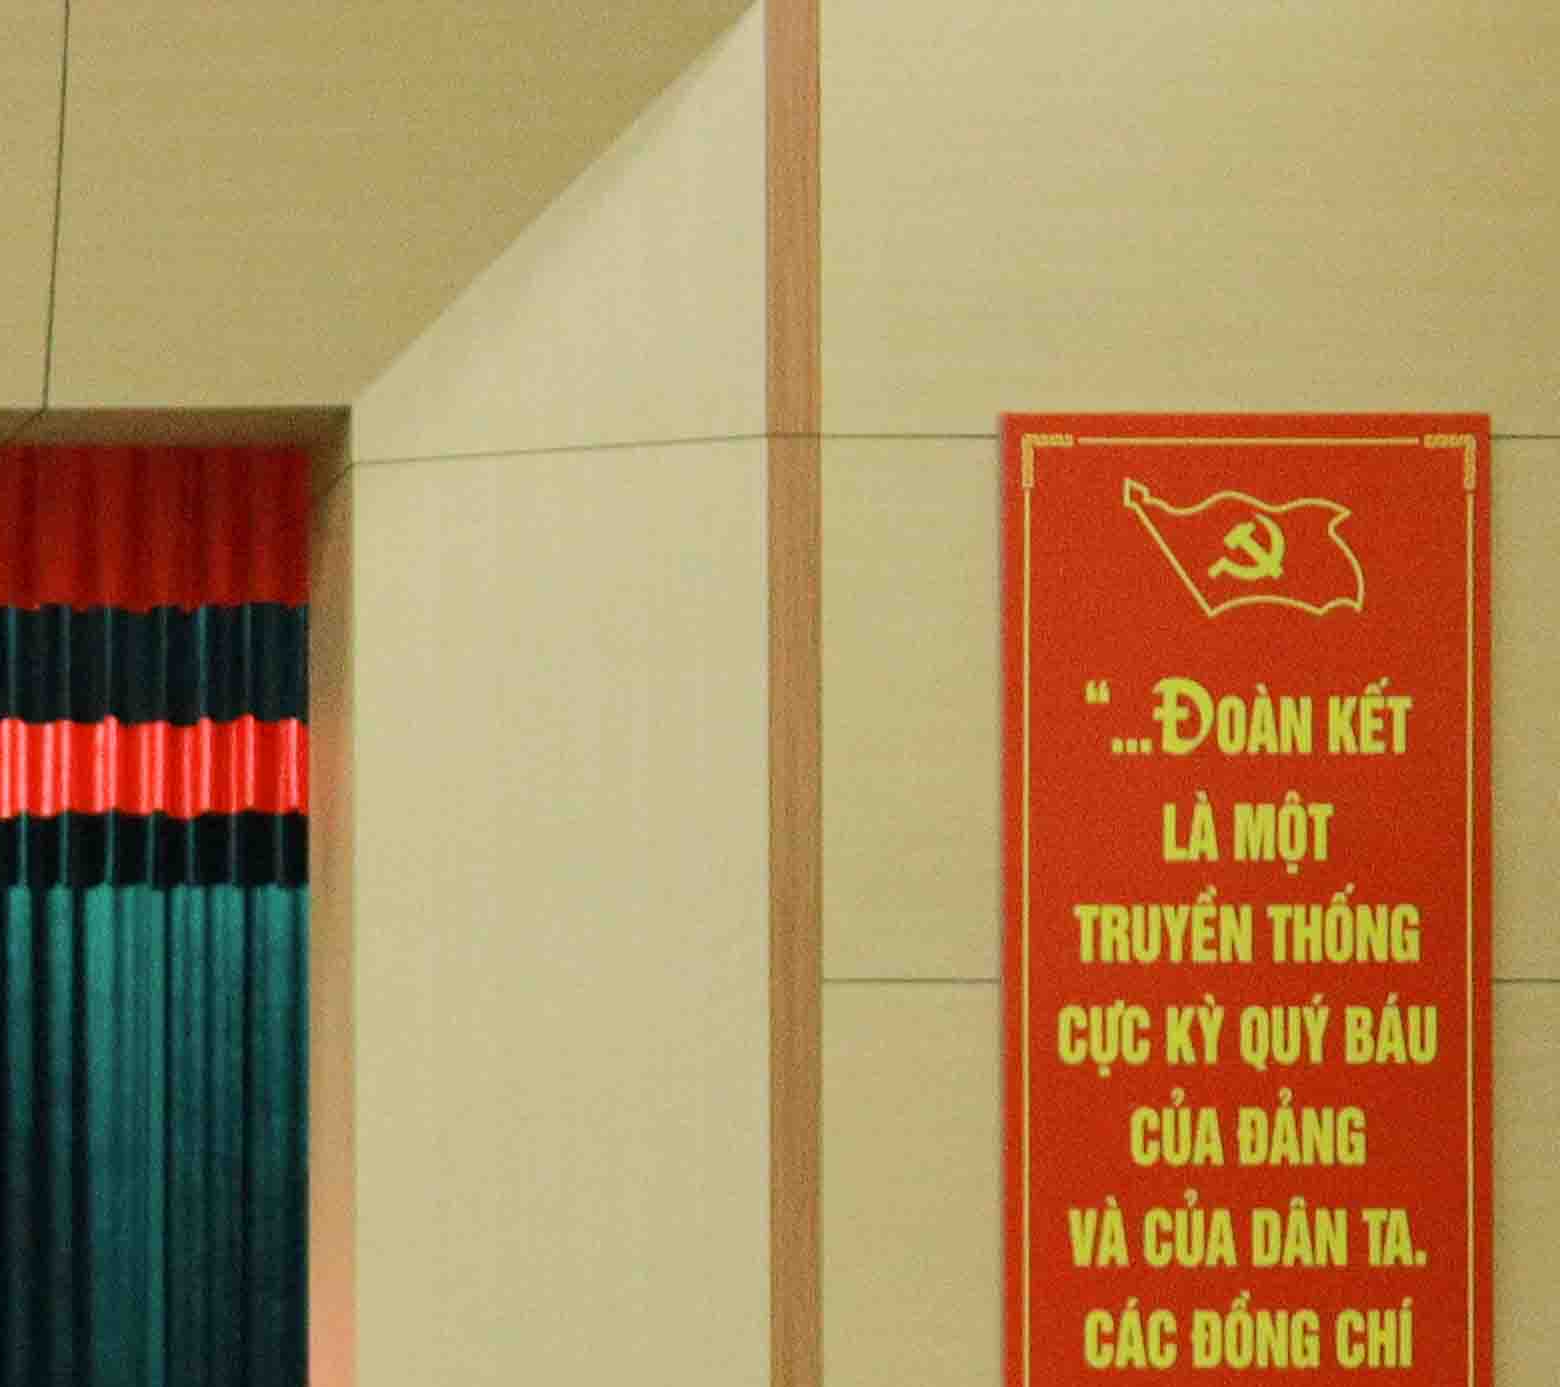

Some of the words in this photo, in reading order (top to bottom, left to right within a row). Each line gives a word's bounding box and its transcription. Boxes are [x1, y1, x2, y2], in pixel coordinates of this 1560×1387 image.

[1328, 678, 1412, 754] KẾT
[1163, 791, 1219, 861] LÀ
[1234, 791, 1334, 874] MỘT
[1074, 886, 1252, 963] TRUYỀN
[1267, 884, 1419, 962] THỐNG
[1058, 1000, 1150, 1077] CỰC
[1166, 994, 1224, 1064] KỲ
[1240, 994, 1329, 1070] QUÝ
[1345, 994, 1436, 1063] BÁU
[1131, 1088, 1223, 1166] CỦA
[1237, 1088, 1365, 1165] ĐẢNG
[1069, 1197, 1128, 1266] VÀ
[1144, 1189, 1237, 1267] CỦA
[1252, 1197, 1347, 1266] DÂN
[1362, 1209, 1426, 1265] TA.
[1085, 1298, 1176, 1369] CÁC
[1191, 1291, 1319, 1369] ĐỒNG
[1336, 1298, 1412, 1368] CHÍ
